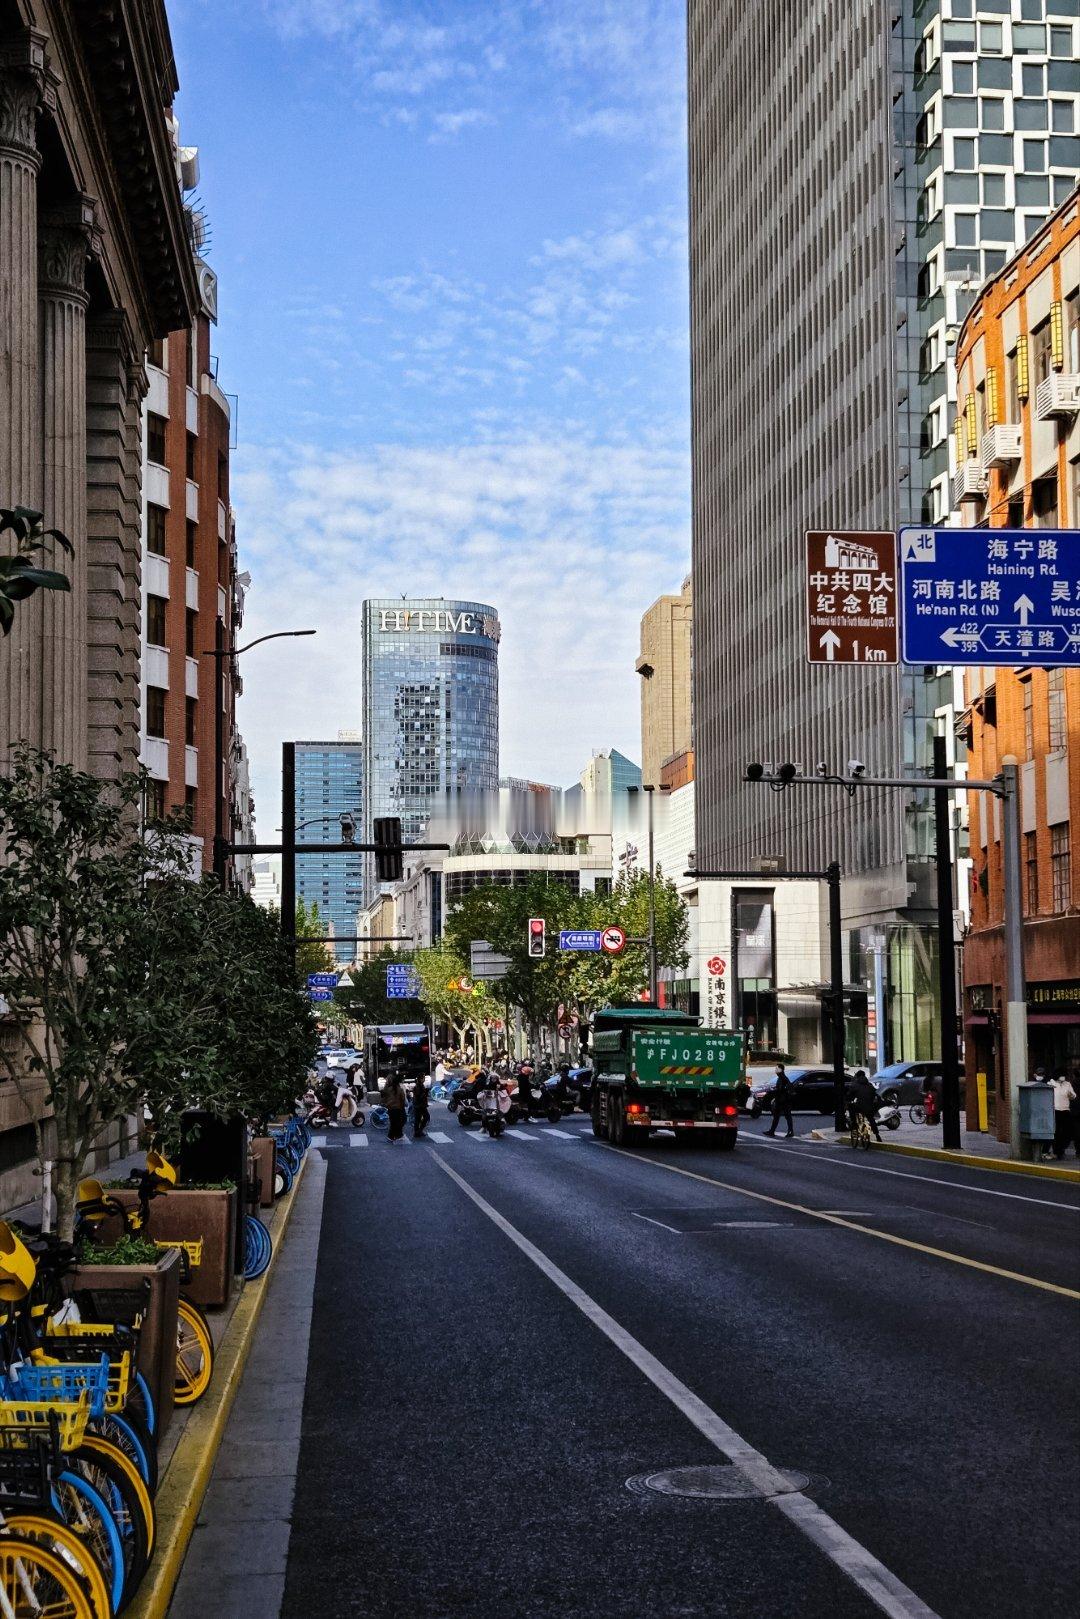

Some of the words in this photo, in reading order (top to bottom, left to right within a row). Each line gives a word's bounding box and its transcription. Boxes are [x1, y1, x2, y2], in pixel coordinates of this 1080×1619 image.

[917, 534, 933, 550] 北
[988, 539, 1058, 560] 海宁路
[810, 571, 894, 592] 中共四大
[988, 564, 1034, 578] Haining
[1040, 564, 1059, 576] Rd.
[912, 579, 1002, 601] 河南北路
[1050, 581, 1080, 602] 吴
[816, 594, 888, 615] 纪念馆
[916, 604, 956, 616] He'nan
[960, 604, 978, 616] Rd.
[982, 604, 999, 616] (N)
[960, 623, 978, 634] 422
[994, 630, 1055, 648] 天潼路
[852, 640, 858, 660] 1
[864, 646, 887, 662] km
[961, 642, 978, 653] 395
[714, 977, 726, 1029] 南京银行
